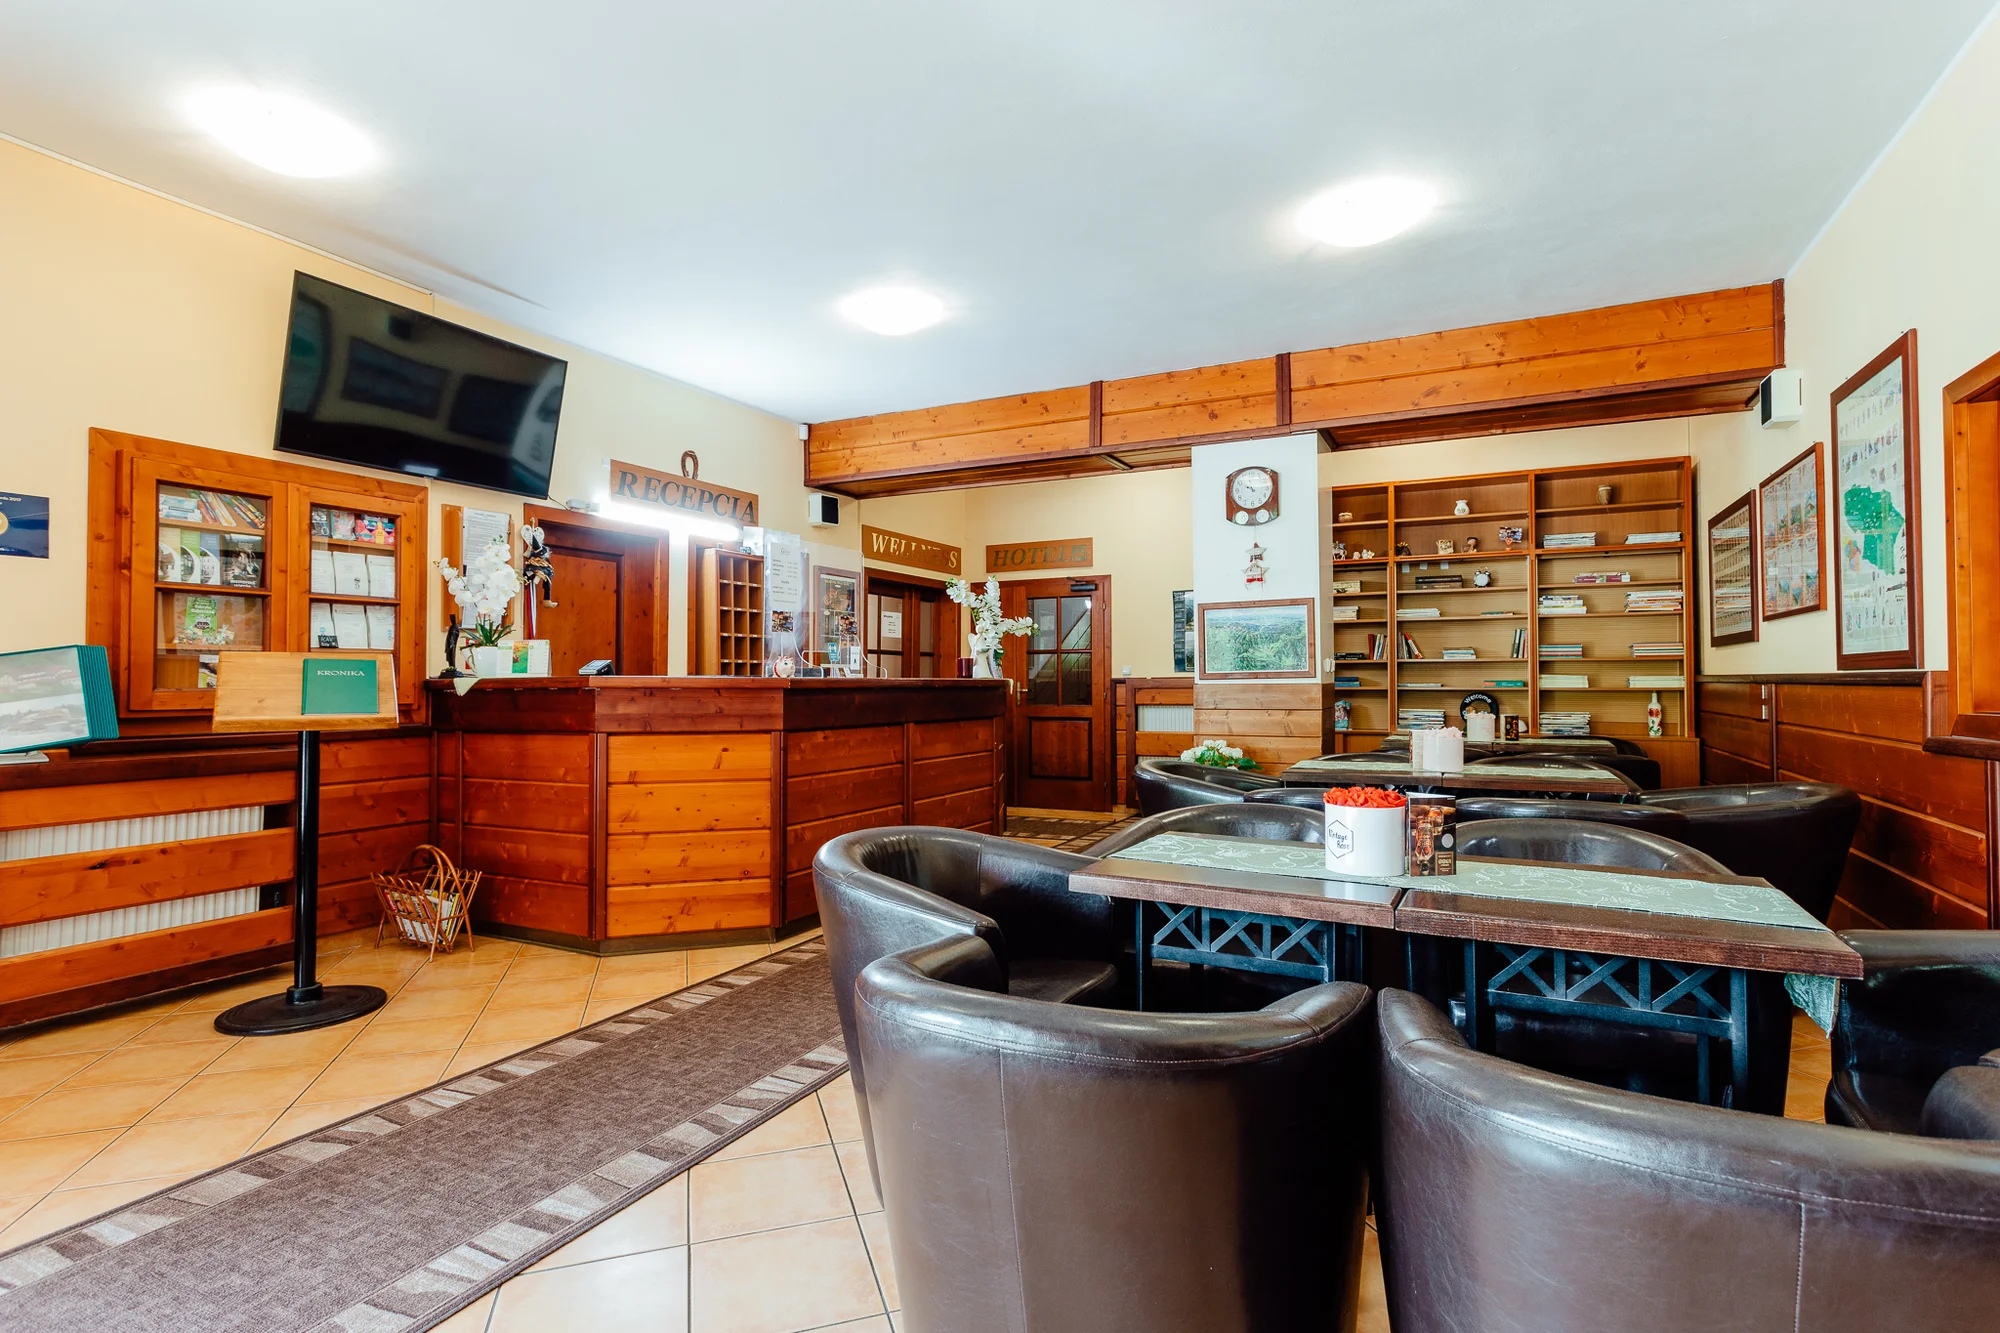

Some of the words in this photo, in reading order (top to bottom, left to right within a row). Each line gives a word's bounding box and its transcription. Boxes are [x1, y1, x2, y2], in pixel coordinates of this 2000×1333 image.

[615, 470, 757, 524] RECEPCIA
[993, 545, 1071, 567] HOTEL
[1464, 694, 1492, 703] Welcome
